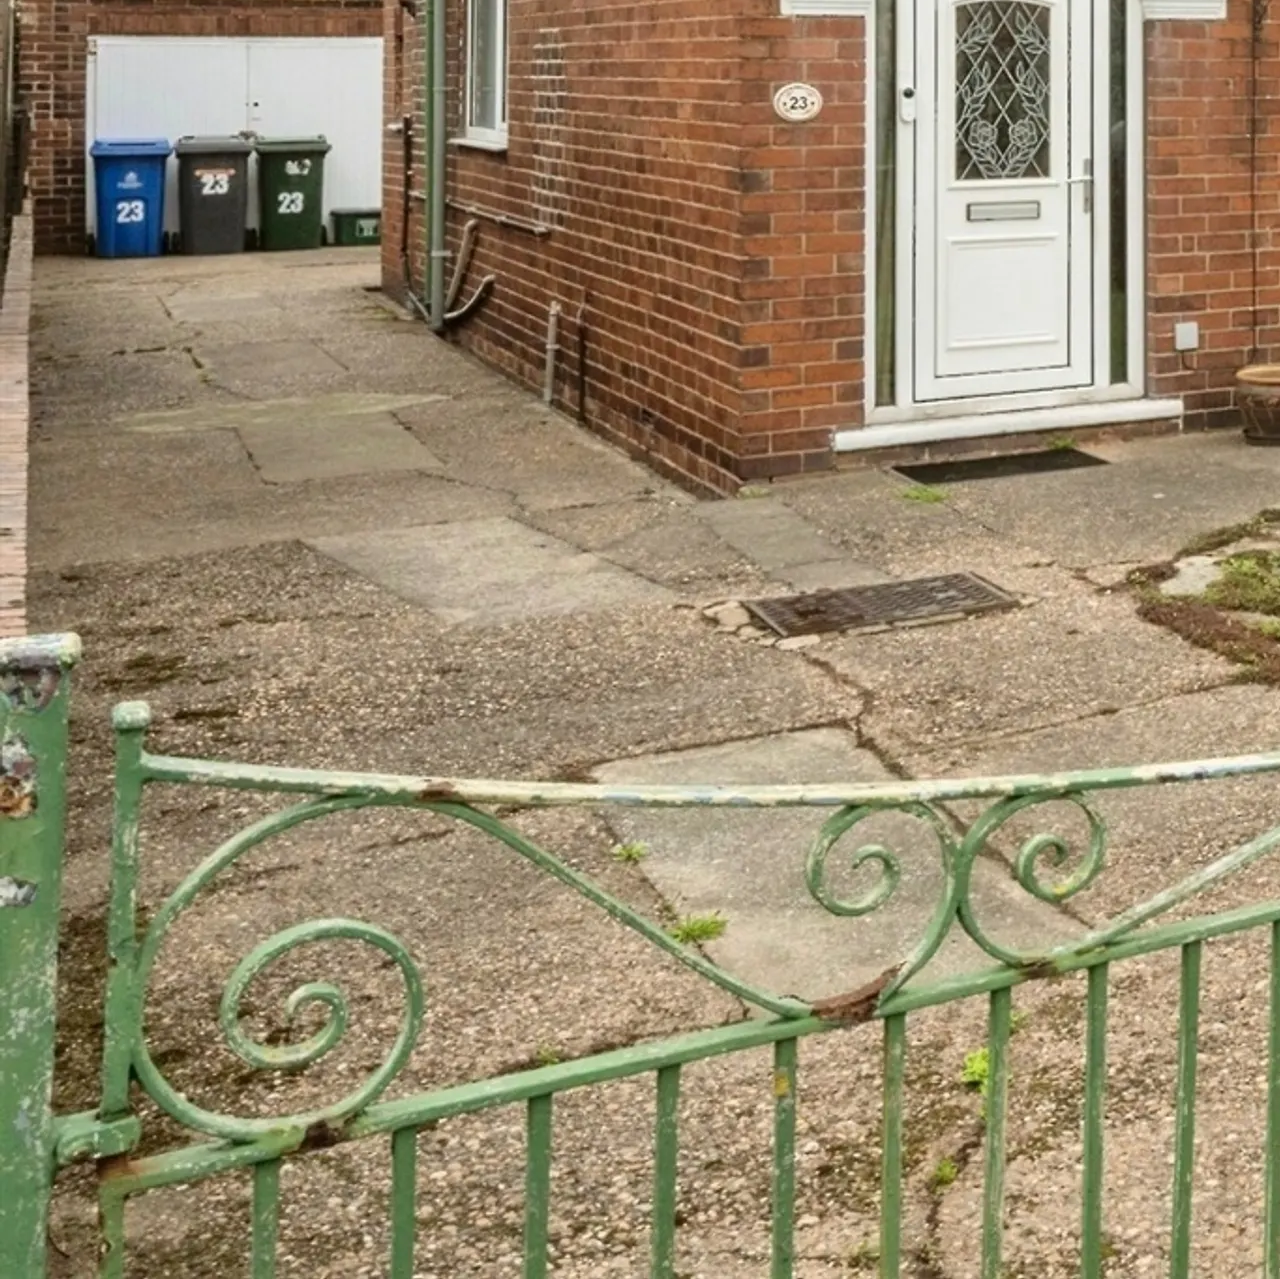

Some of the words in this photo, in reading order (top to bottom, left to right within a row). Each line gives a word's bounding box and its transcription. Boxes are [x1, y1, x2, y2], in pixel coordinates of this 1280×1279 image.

[789, 96, 808, 110] 23
[200, 173, 229, 195] 23
[116, 200, 144, 223] 23
[277, 191, 304, 214] 23
